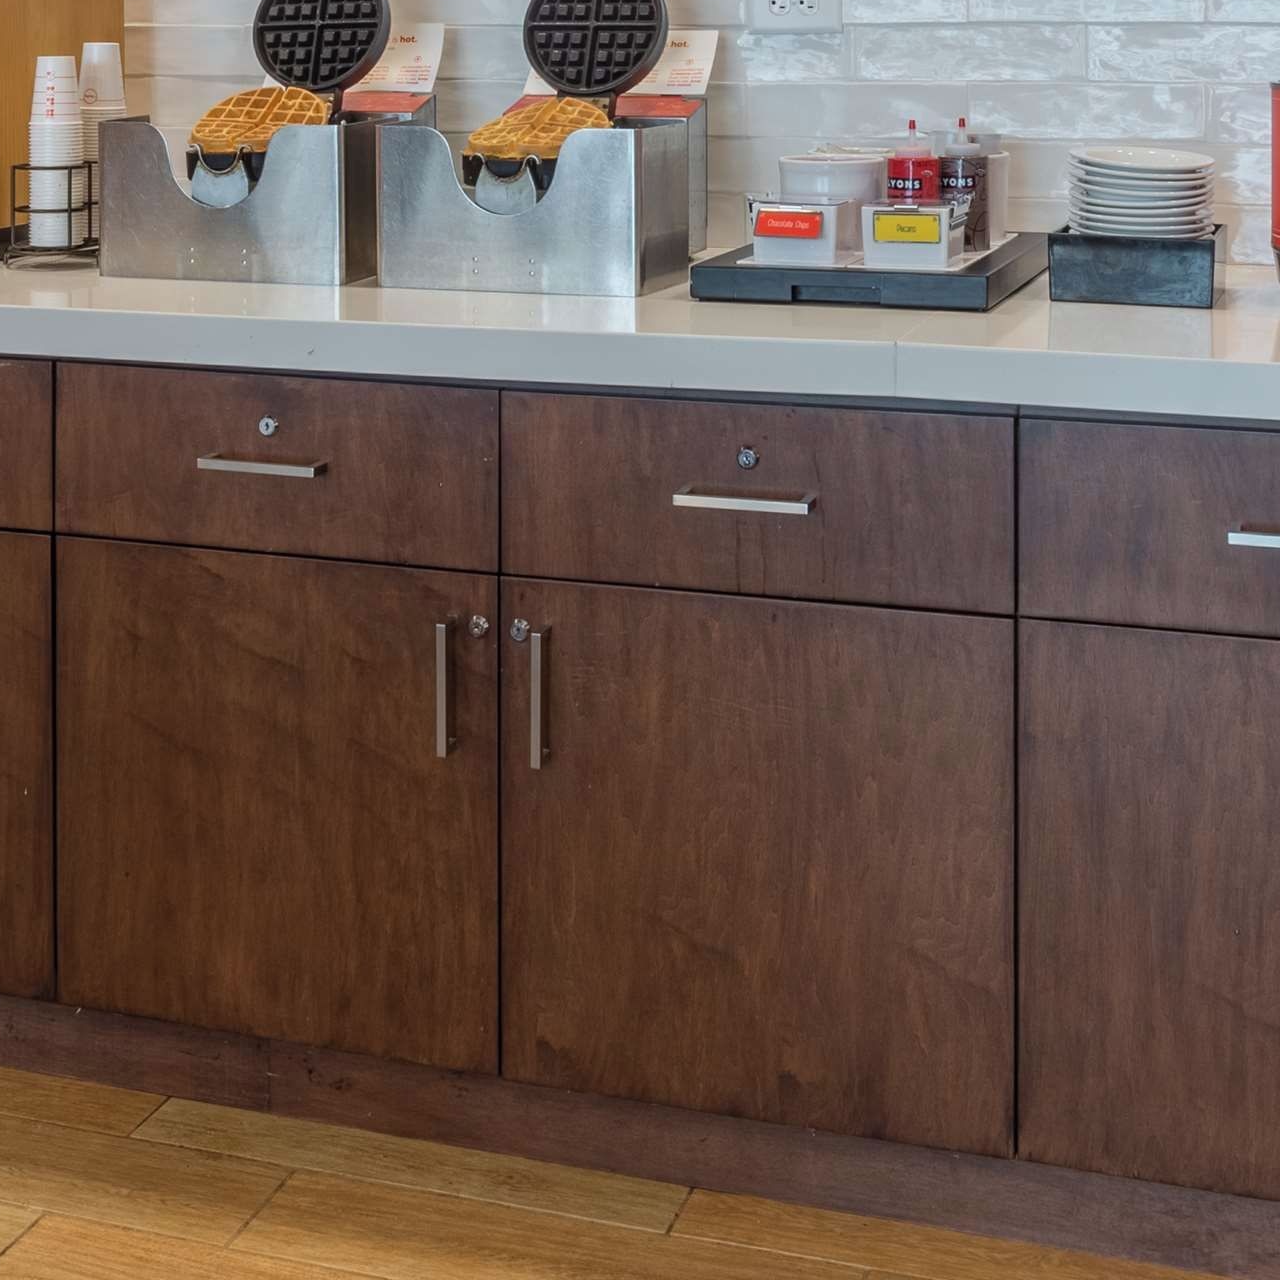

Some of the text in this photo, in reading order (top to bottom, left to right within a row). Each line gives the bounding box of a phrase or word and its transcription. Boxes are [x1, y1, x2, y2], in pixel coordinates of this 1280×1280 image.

[400, 35, 417, 43] hot.
[670, 40, 689, 48] hot.
[888, 179, 921, 189] YONS
[940, 178, 974, 188] YONS
